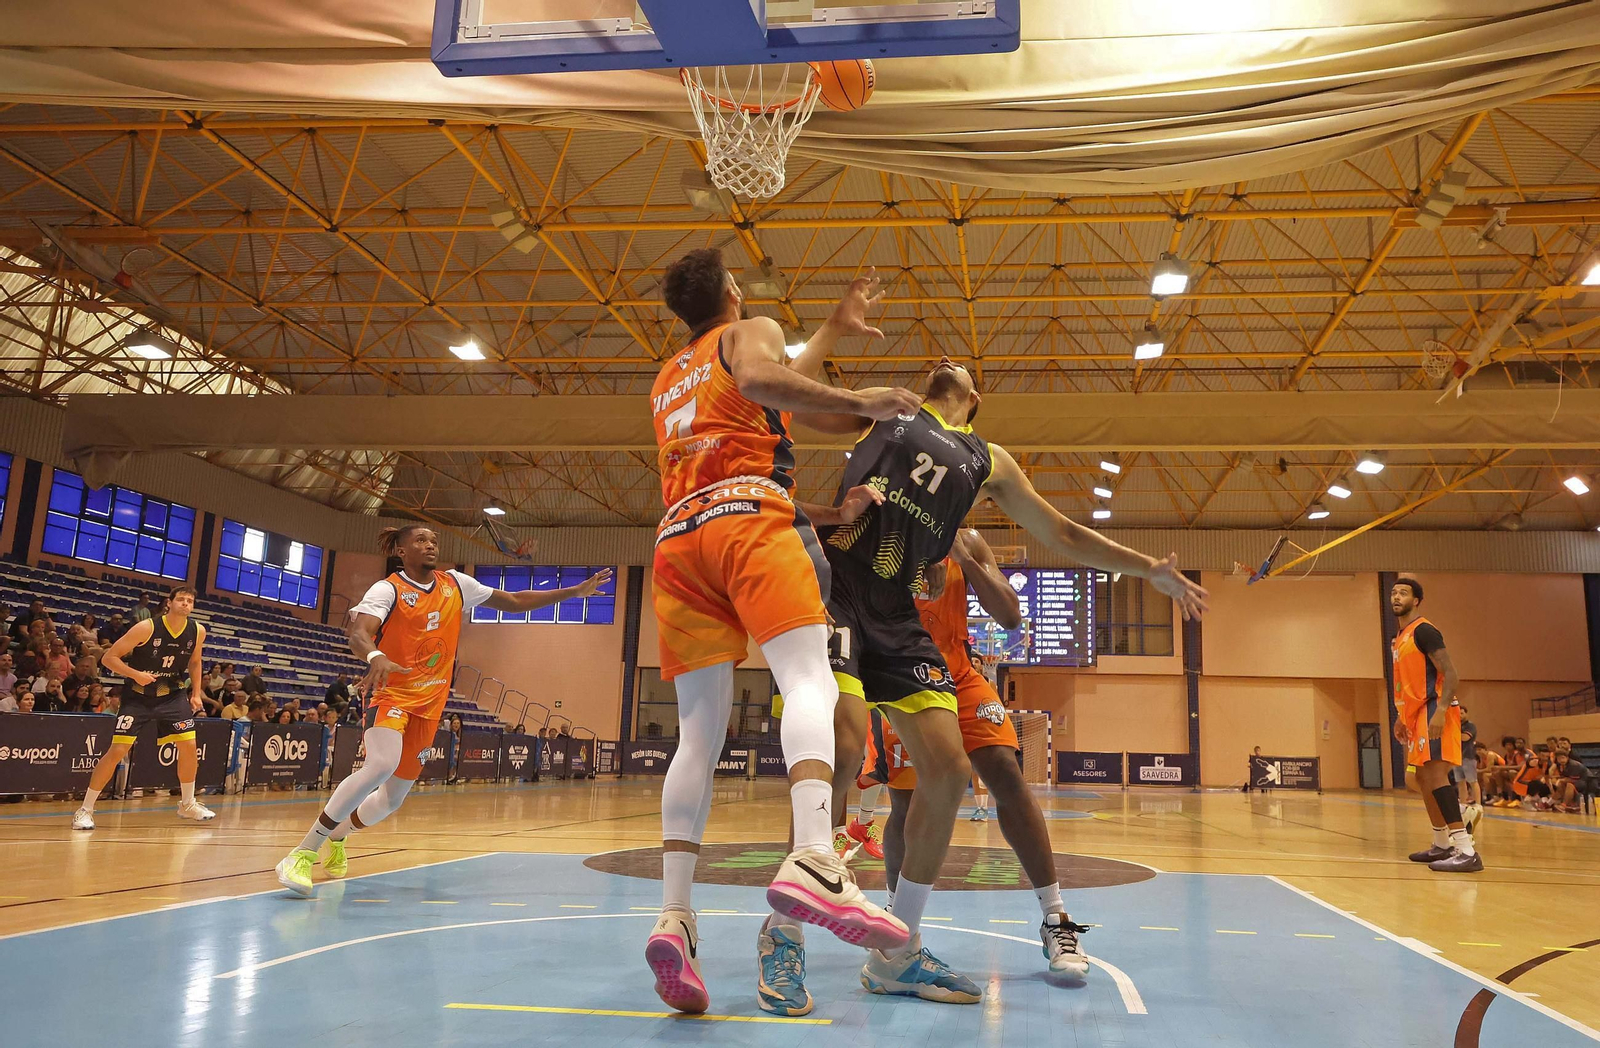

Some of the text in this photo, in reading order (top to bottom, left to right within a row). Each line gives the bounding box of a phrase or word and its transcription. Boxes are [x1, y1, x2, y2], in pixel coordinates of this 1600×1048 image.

[664, 394, 697, 440] 7
[909, 452, 949, 495] 21
[427, 610, 440, 632] 2
[115, 714, 134, 730] 13
[11, 743, 60, 764] surpool
[284, 732, 308, 760] ice
[71, 757, 101, 769] LABO
[1072, 770, 1107, 778] ASESORES
[1142, 770, 1179, 780] SAAVEDRA
